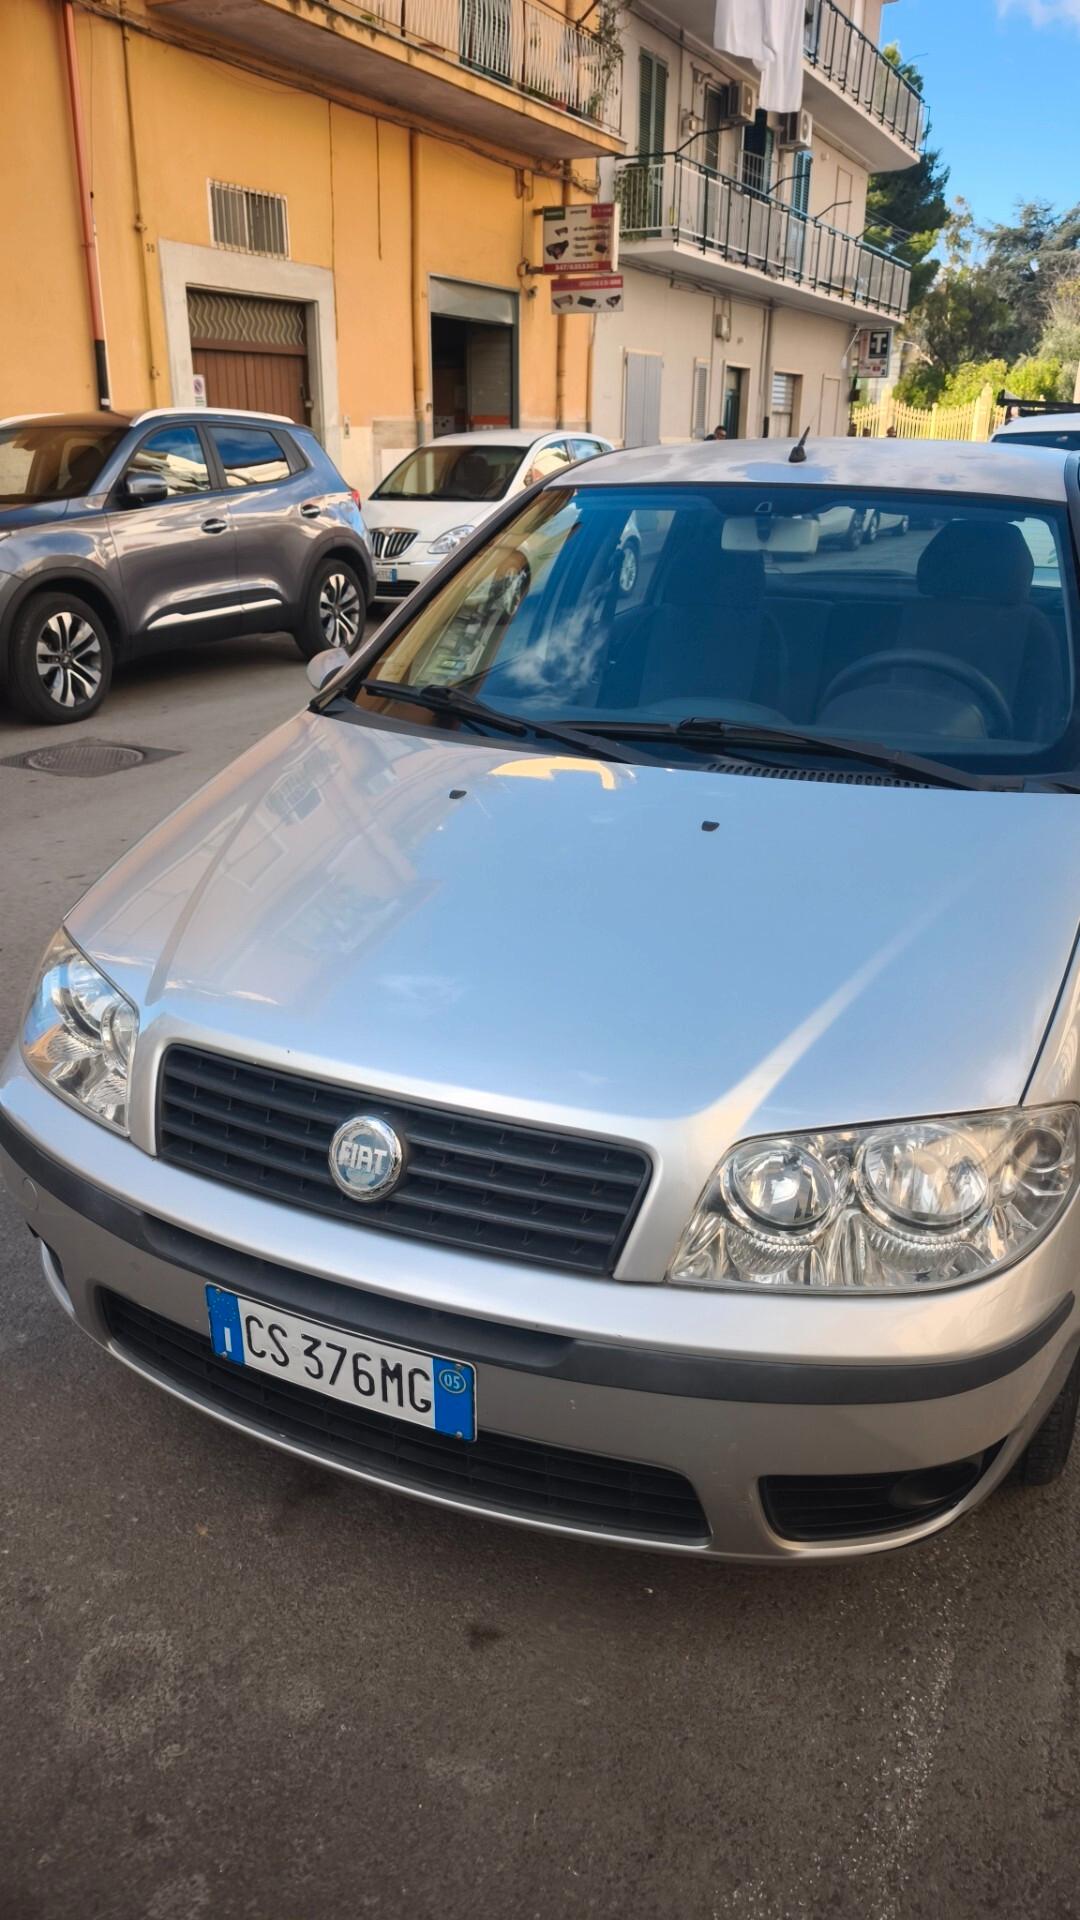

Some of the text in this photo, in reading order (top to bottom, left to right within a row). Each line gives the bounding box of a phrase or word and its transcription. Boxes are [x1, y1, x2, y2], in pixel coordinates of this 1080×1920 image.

[338, 1140, 388, 1175] FIAT
[245, 1314, 290, 1367] CS
[443, 1373, 461, 1390] 05
